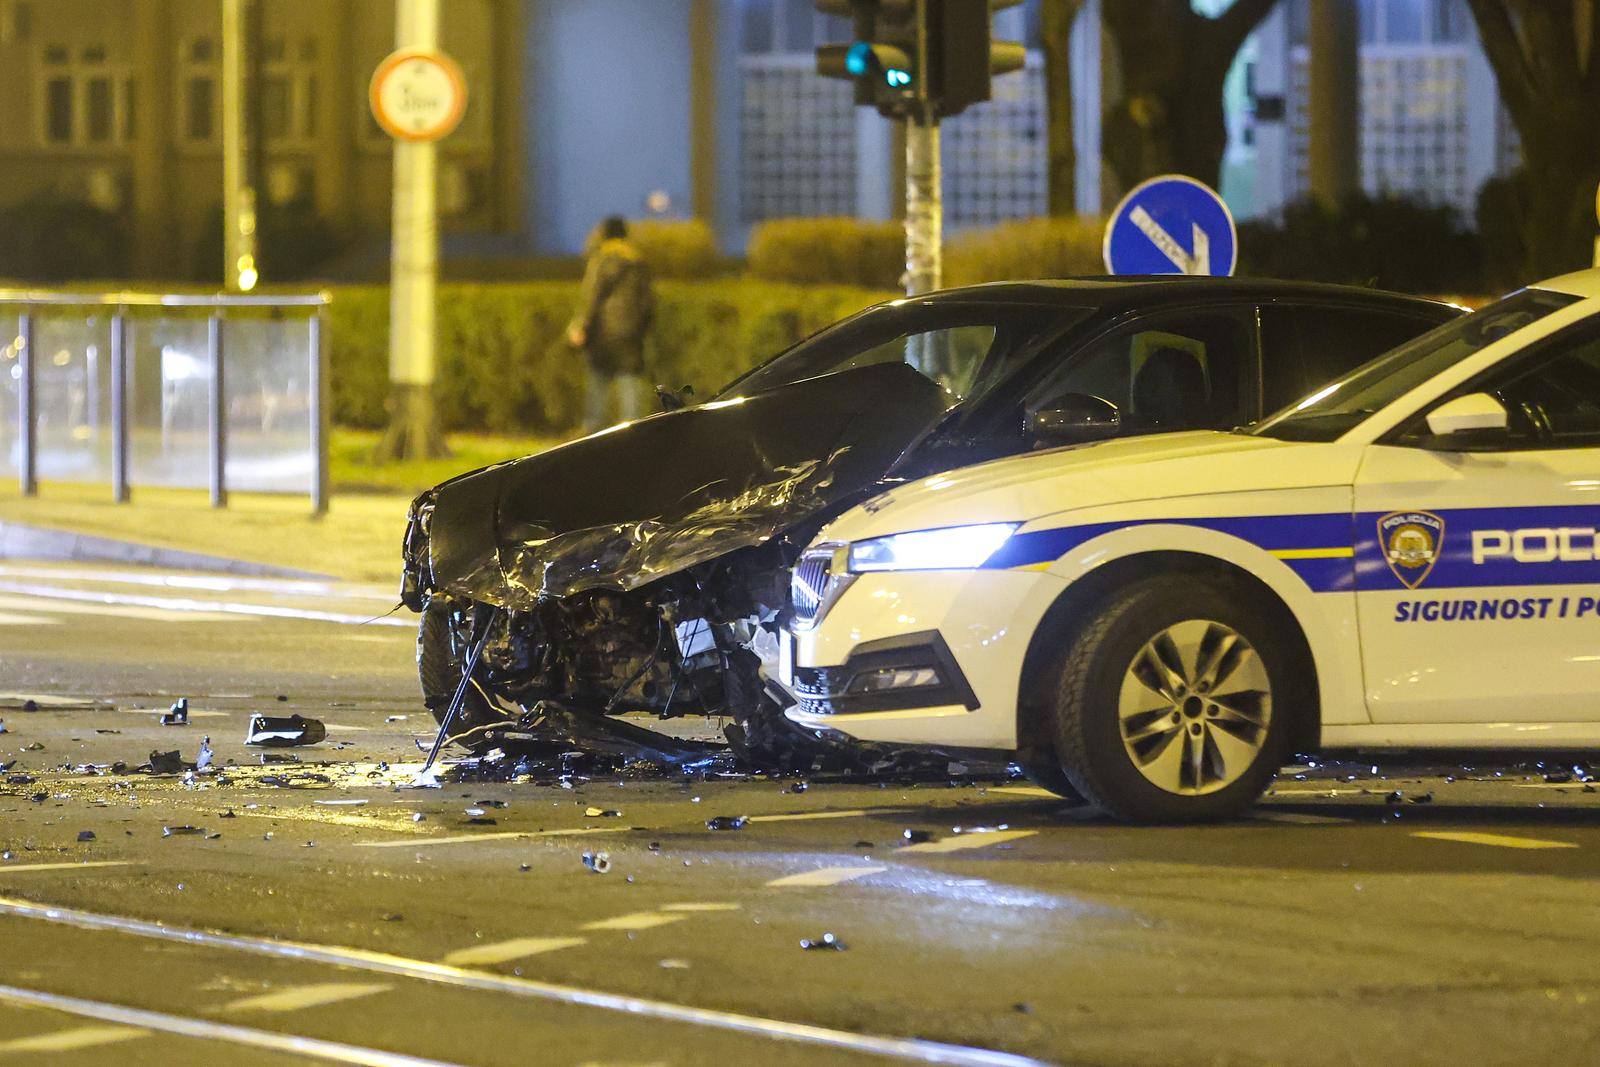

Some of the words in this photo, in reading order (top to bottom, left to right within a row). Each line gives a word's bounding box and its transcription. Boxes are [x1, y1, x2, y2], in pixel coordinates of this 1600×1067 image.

[1383, 514, 1440, 530] POLICIJA
[1395, 598, 1553, 622] SIGURNOST
[1559, 597, 1569, 618] I
[1576, 597, 1600, 618] P
